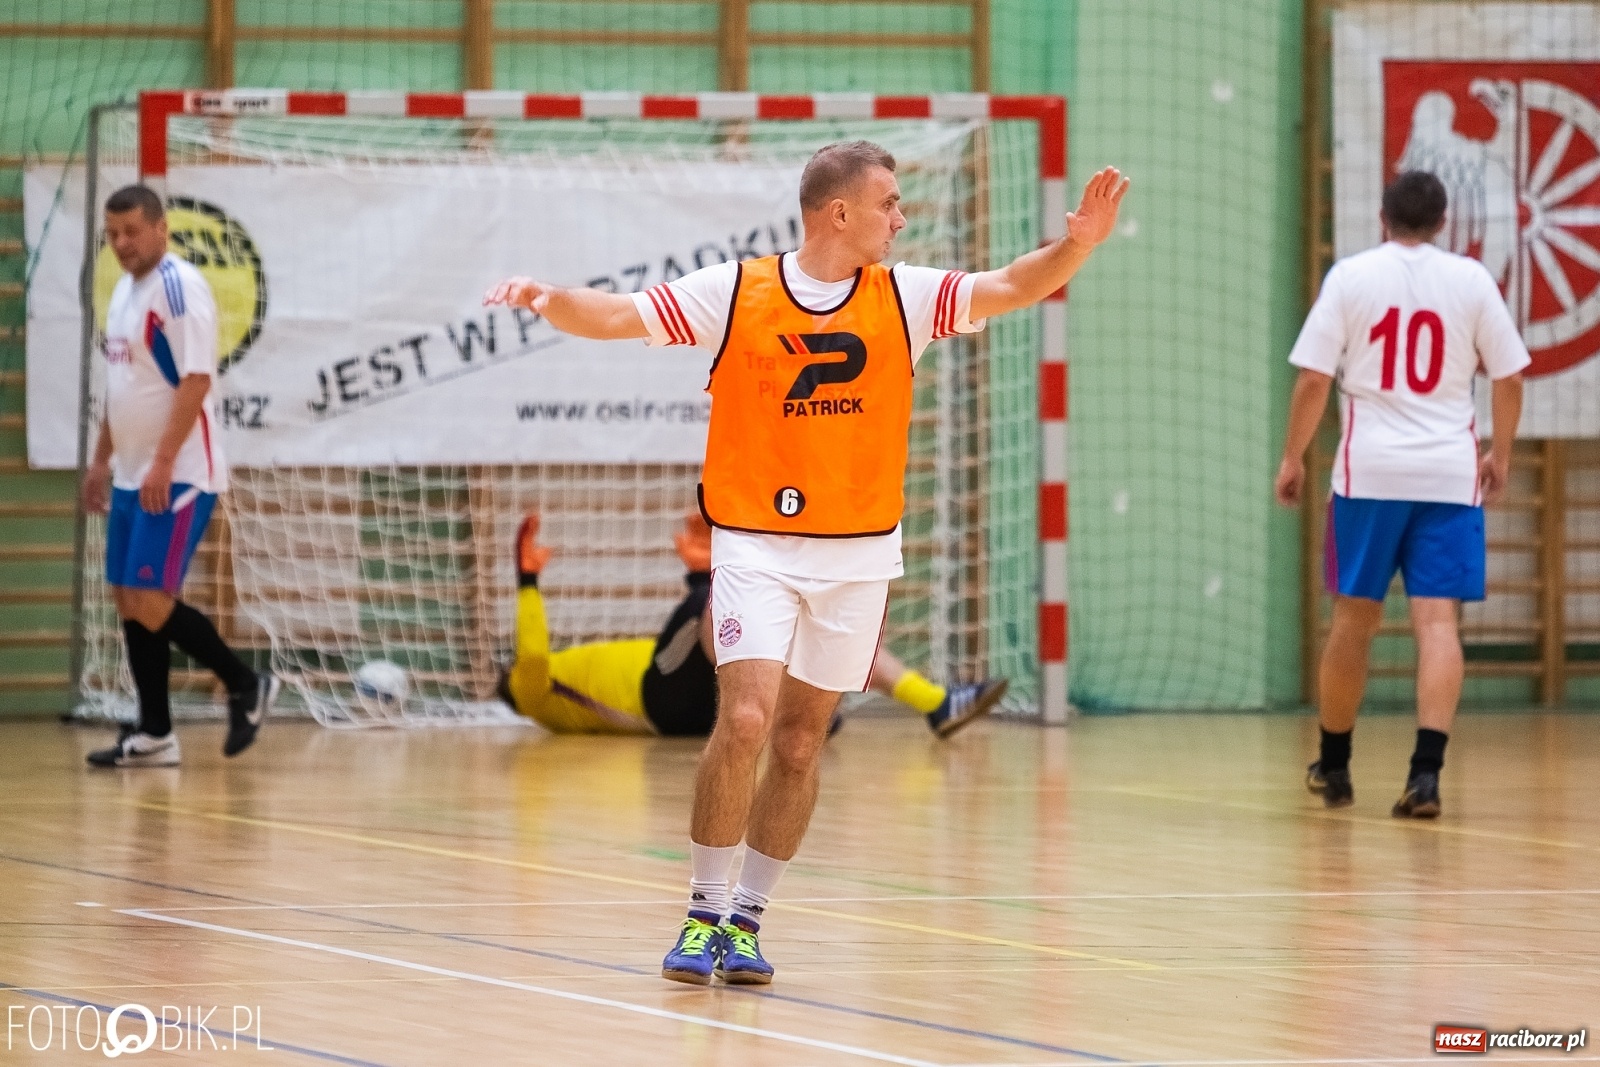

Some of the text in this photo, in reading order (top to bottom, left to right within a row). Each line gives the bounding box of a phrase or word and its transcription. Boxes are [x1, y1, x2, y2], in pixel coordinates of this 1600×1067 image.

[306, 333, 430, 412] JEST
[446, 311, 496, 363] W
[1368, 306, 1445, 396] 10
[782, 398, 864, 418] PATRICK
[780, 487, 799, 515] 6
